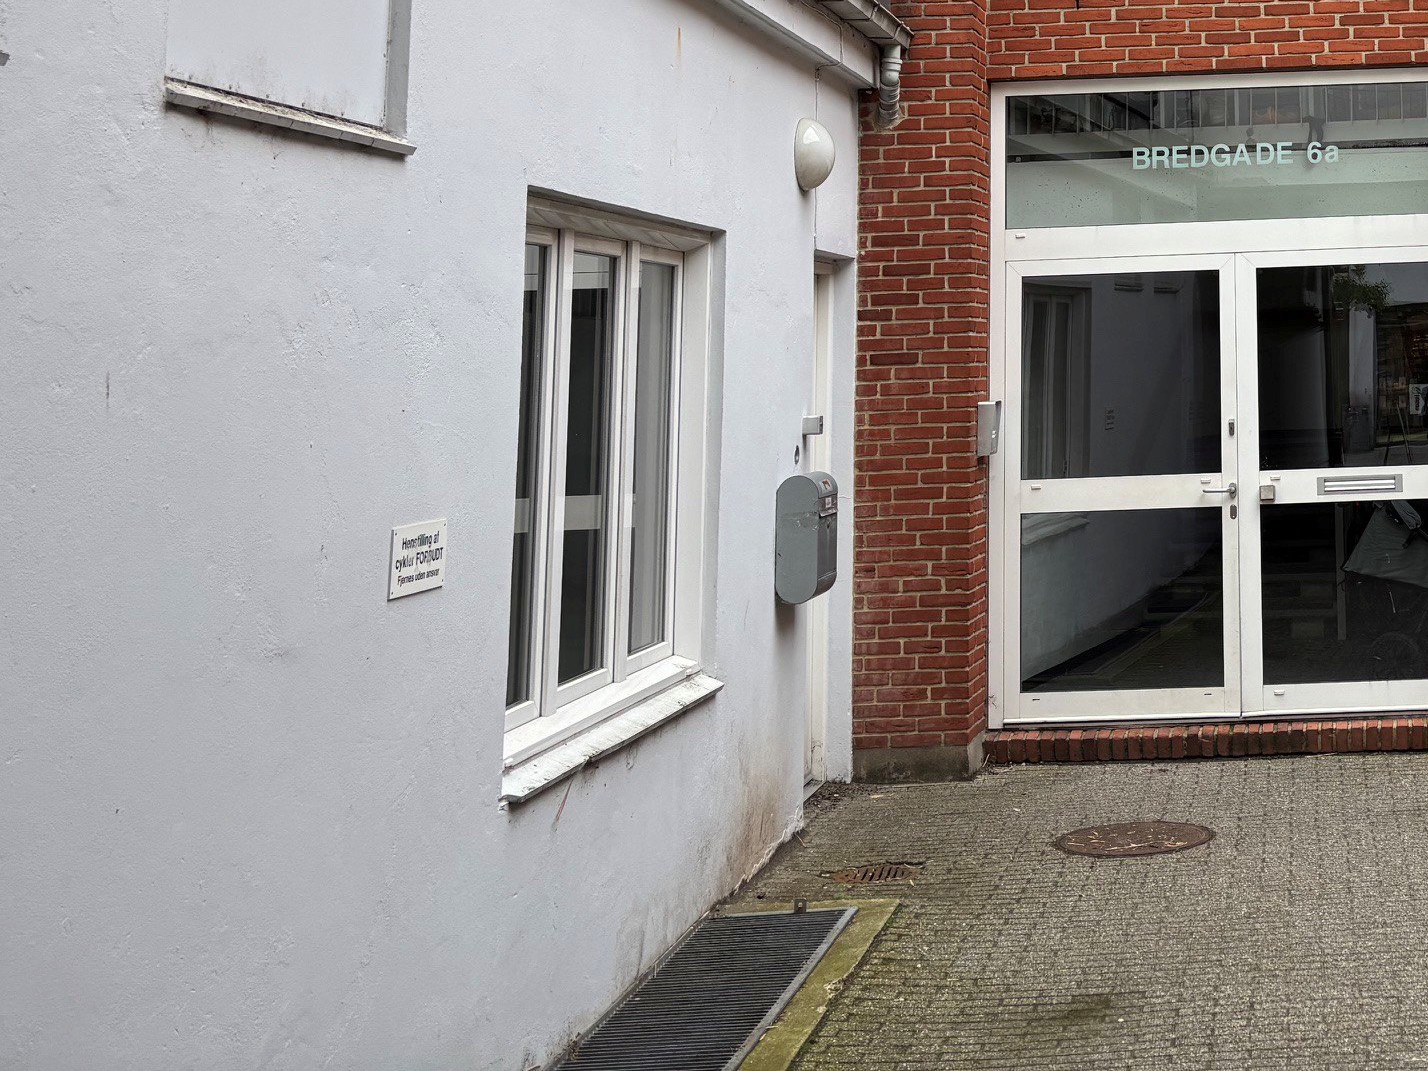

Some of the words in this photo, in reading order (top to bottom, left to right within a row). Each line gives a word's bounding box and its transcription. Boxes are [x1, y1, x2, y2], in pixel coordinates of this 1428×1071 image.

[1132, 141, 1294, 170] BREDGADE
[1306, 141, 1339, 164] 6a
[402, 533, 432, 550] Henstilling
[433, 531, 440, 544] af
[395, 555, 415, 572] cykler
[416, 547, 443, 566] FORBUDT
[397, 574, 414, 587] Fjernes
[415, 571, 426, 581] uden
